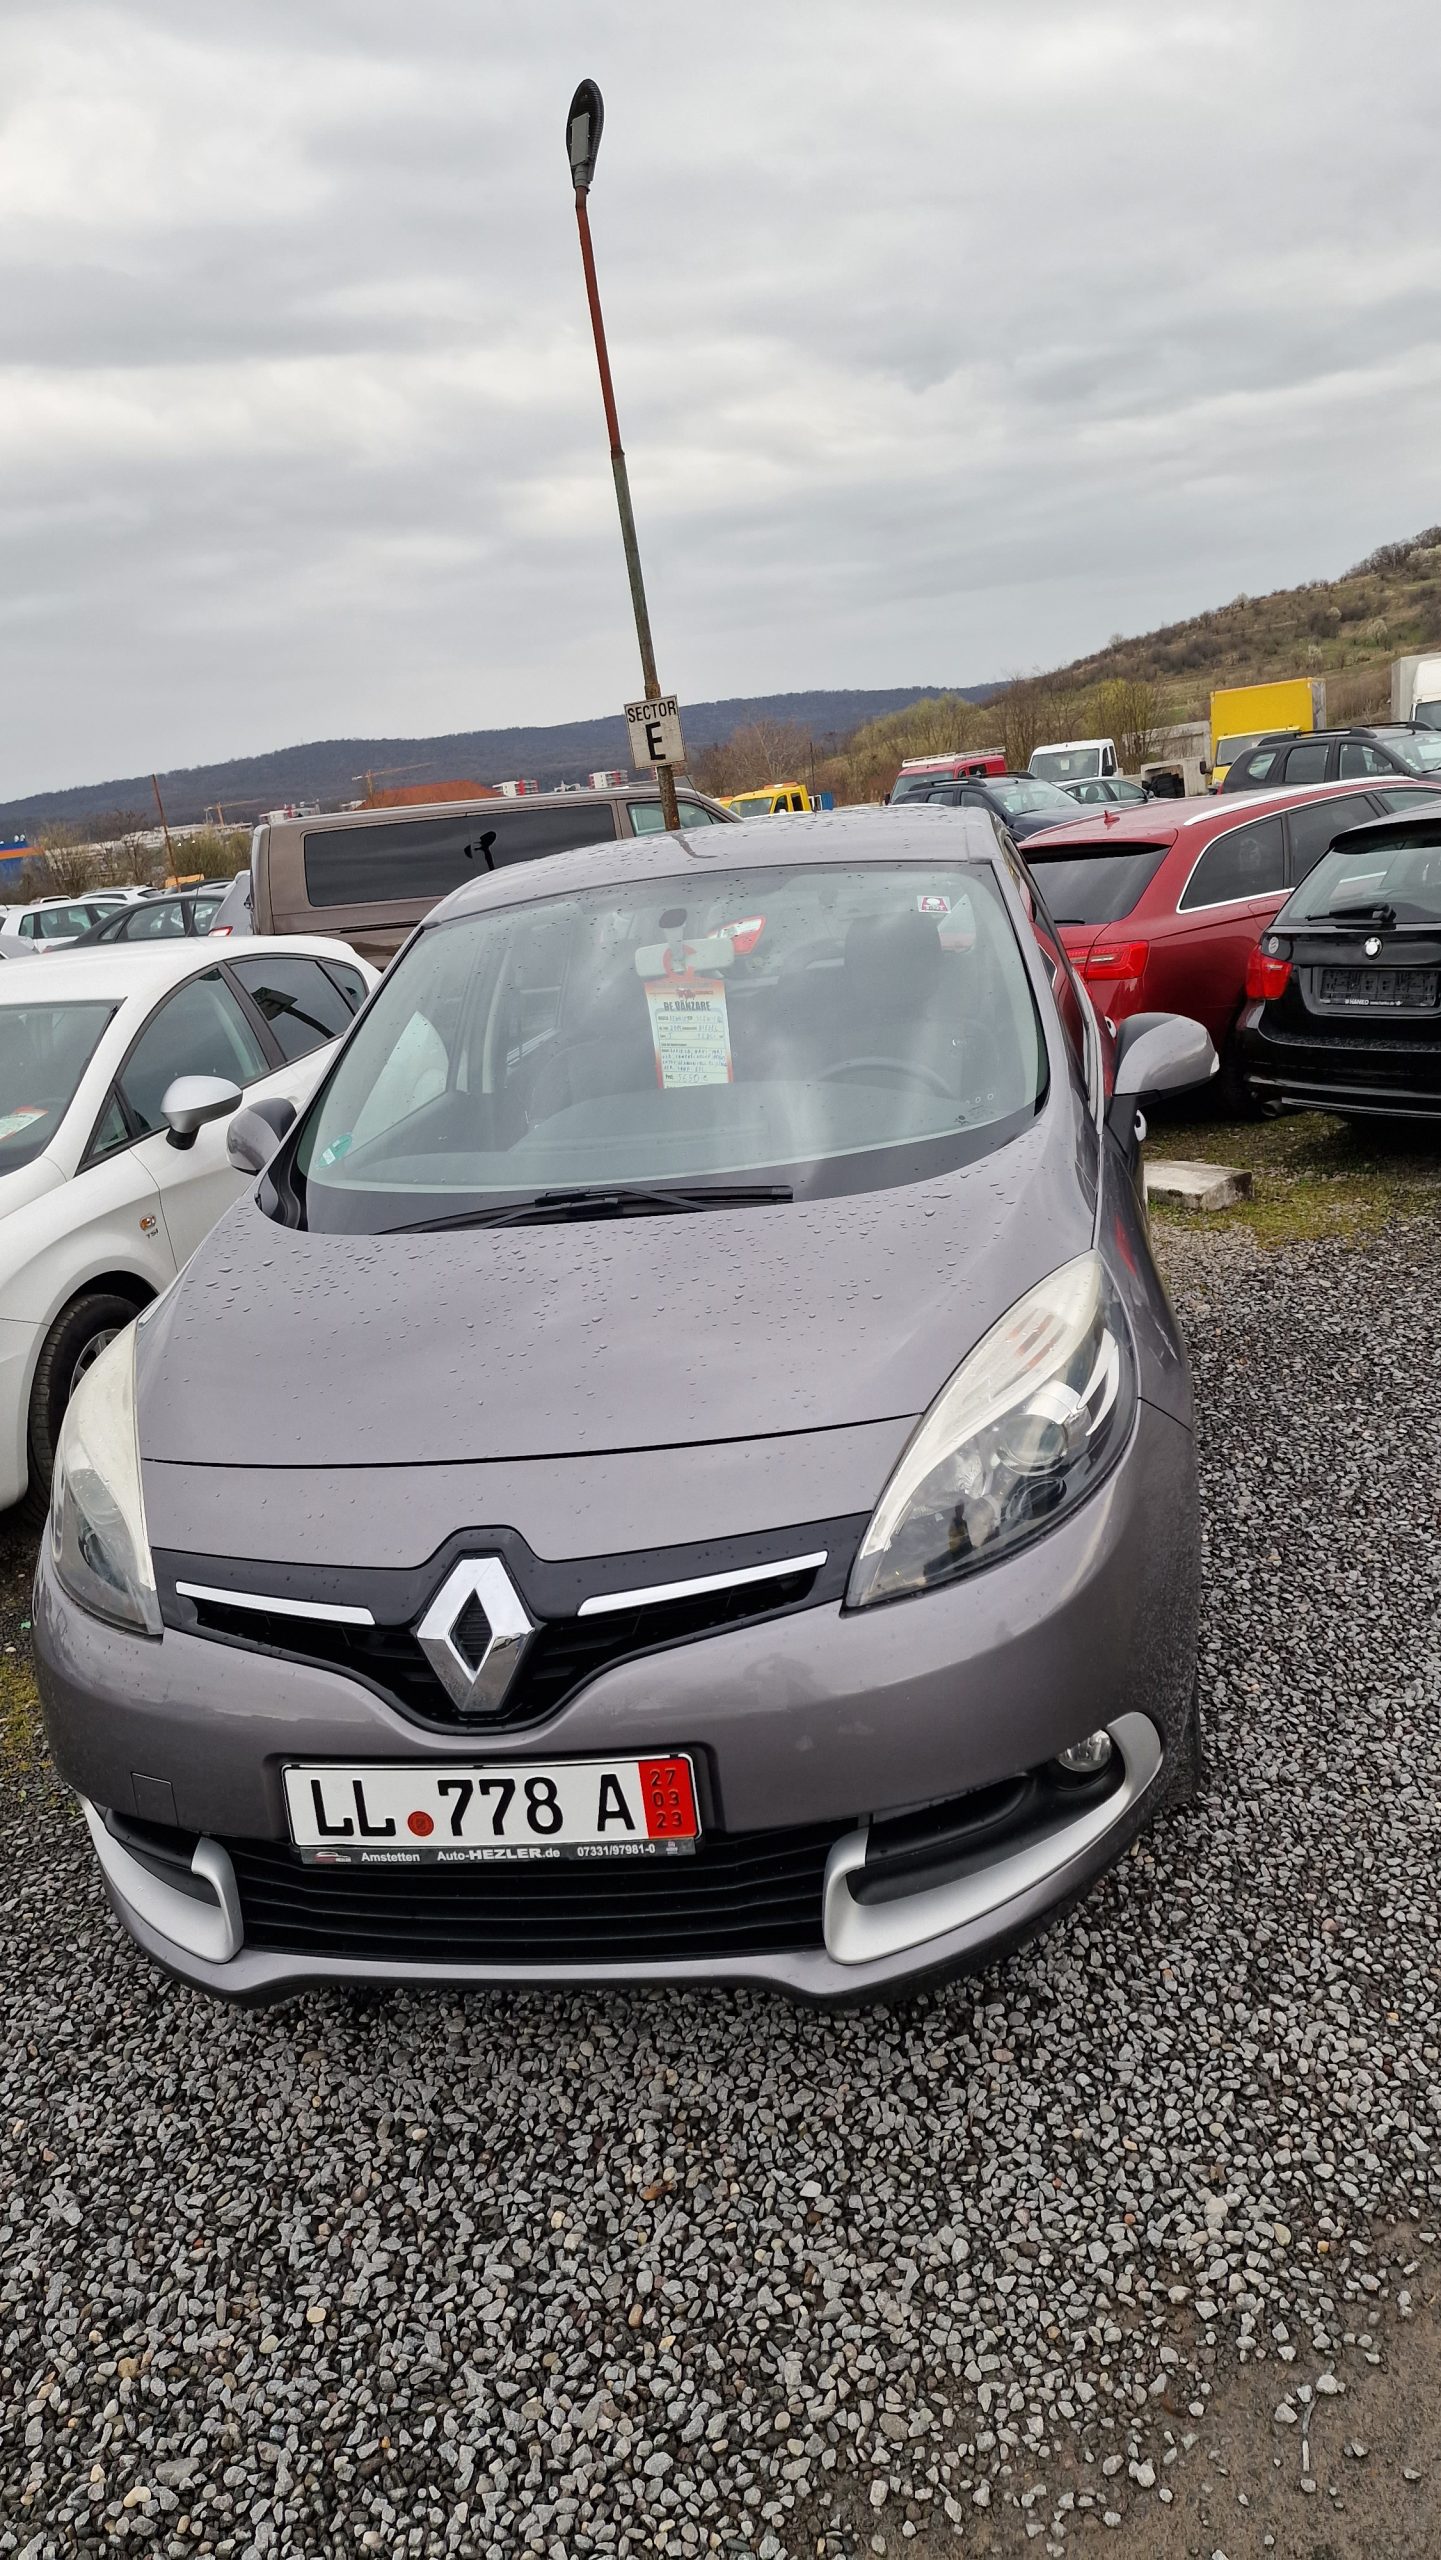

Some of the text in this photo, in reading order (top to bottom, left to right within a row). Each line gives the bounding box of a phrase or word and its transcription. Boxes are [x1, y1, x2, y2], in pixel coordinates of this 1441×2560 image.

[627, 701, 677, 723] SECTOR
[645, 721, 666, 760] E
[650, 1769, 676, 1787] 27
[310, 1773, 636, 1837] LL 778 A
[652, 1788, 680, 1808] 03
[655, 1810, 683, 1829] 23
[361, 1852, 421, 1862] Amstetten
[437, 1847, 561, 1861] Auto-HEZLER.de
[577, 1843, 656, 1857] 07331/97981-0
